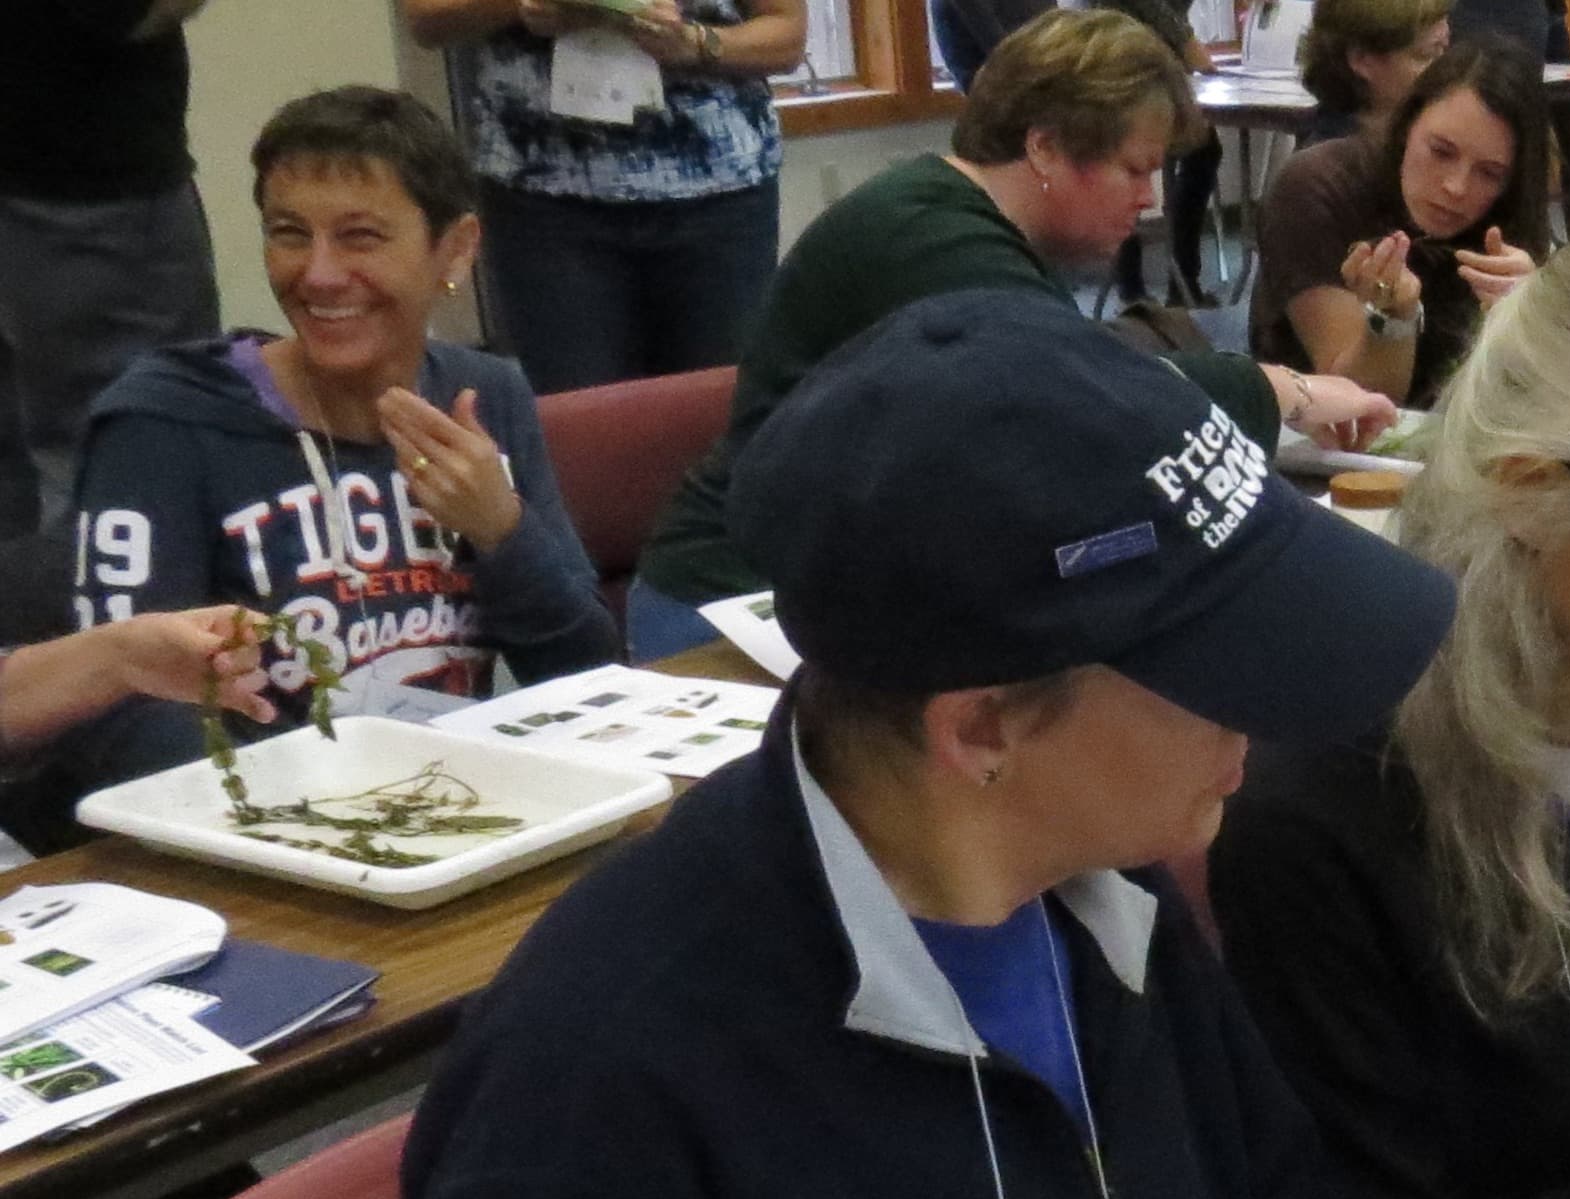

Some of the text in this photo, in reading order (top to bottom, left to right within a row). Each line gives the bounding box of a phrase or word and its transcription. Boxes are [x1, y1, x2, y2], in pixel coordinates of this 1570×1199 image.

[222, 455, 515, 597] TIGE
[1186, 497, 1211, 527] of
[1203, 515, 1240, 549] the
